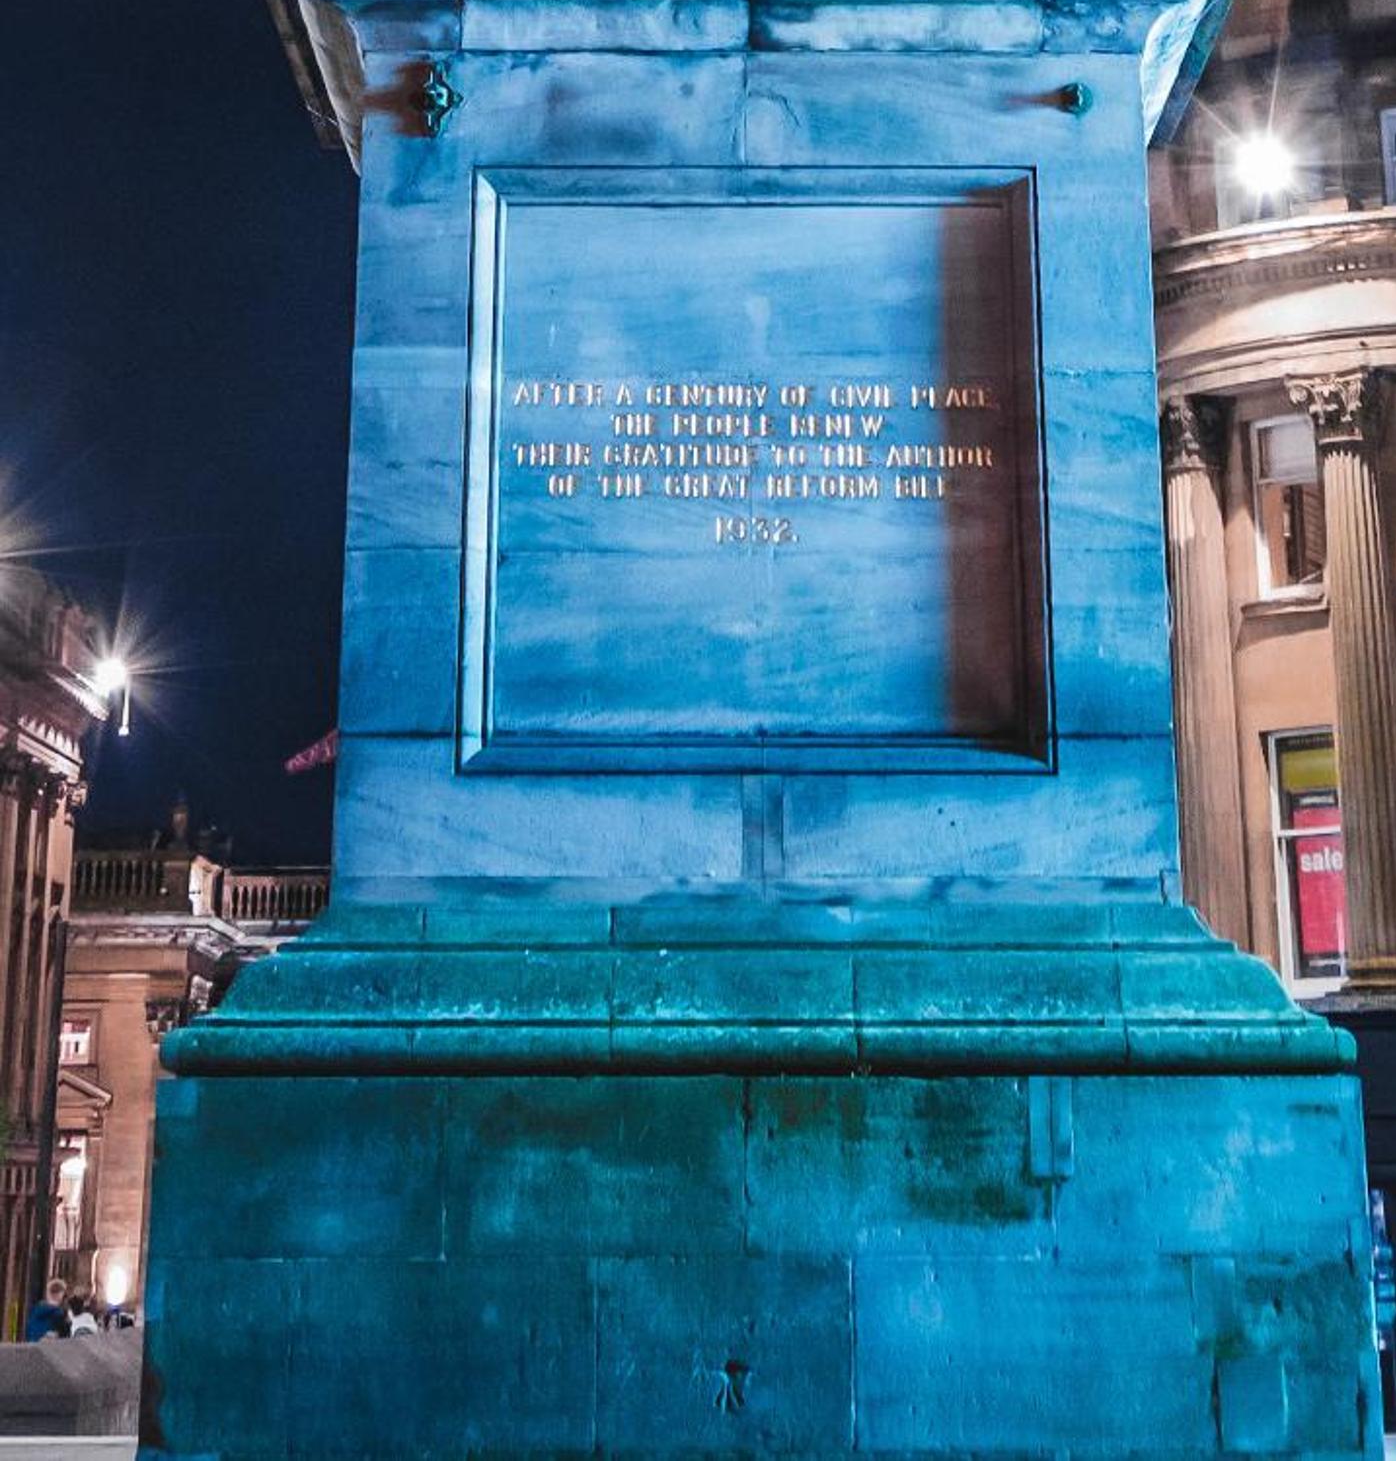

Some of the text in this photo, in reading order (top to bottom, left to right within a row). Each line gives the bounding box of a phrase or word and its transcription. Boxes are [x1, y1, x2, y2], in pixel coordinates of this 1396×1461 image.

[513, 382, 995, 410] AFTER A CENTURY OF CIVIL PEACE
[610, 412, 886, 438] THE PEOPLE RENEW
[513, 441, 994, 469] THEIR GRATITUDE TO THE AUTHOR
[549, 472, 954, 499] OF THE GREAT REFORM BILL
[1300, 848, 1344, 872] sale
